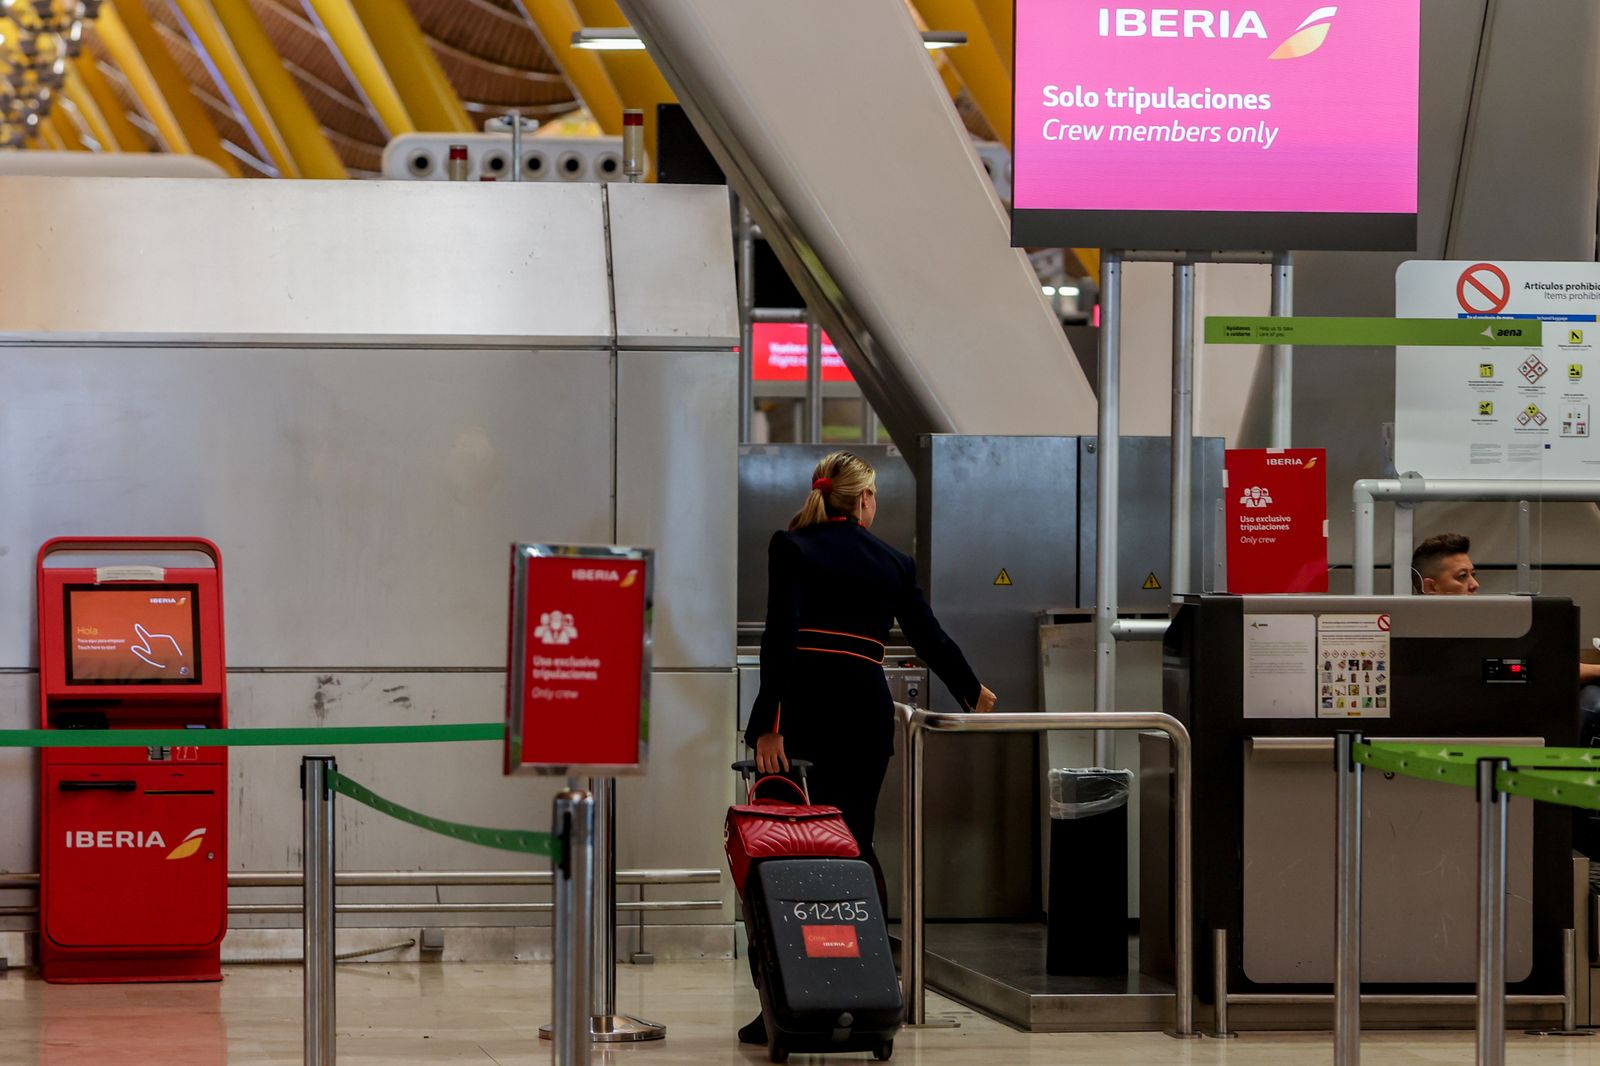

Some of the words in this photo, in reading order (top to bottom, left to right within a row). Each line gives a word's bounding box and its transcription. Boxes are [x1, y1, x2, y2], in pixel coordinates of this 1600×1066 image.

[1099, 8, 1268, 39] IBERIA
[1042, 85, 1099, 108] Solo
[1105, 87, 1271, 114] tripulaciones
[1042, 119, 1104, 141] Crew
[1109, 120, 1221, 143] members
[1227, 121, 1279, 150] only
[1544, 292, 1567, 300] Items
[1497, 329, 1522, 337] aena
[1266, 458, 1303, 466] IBERIA
[1240, 515, 1254, 523] Uso
[1255, 515, 1292, 523] exclusivo
[1240, 523, 1290, 532] tripulaciones
[1240, 536, 1258, 545] Only
[572, 569, 619, 581] IBERIA
[77, 626, 98, 636] Hola
[532, 687, 554, 701] Only
[66, 831, 166, 848] IBERIA
